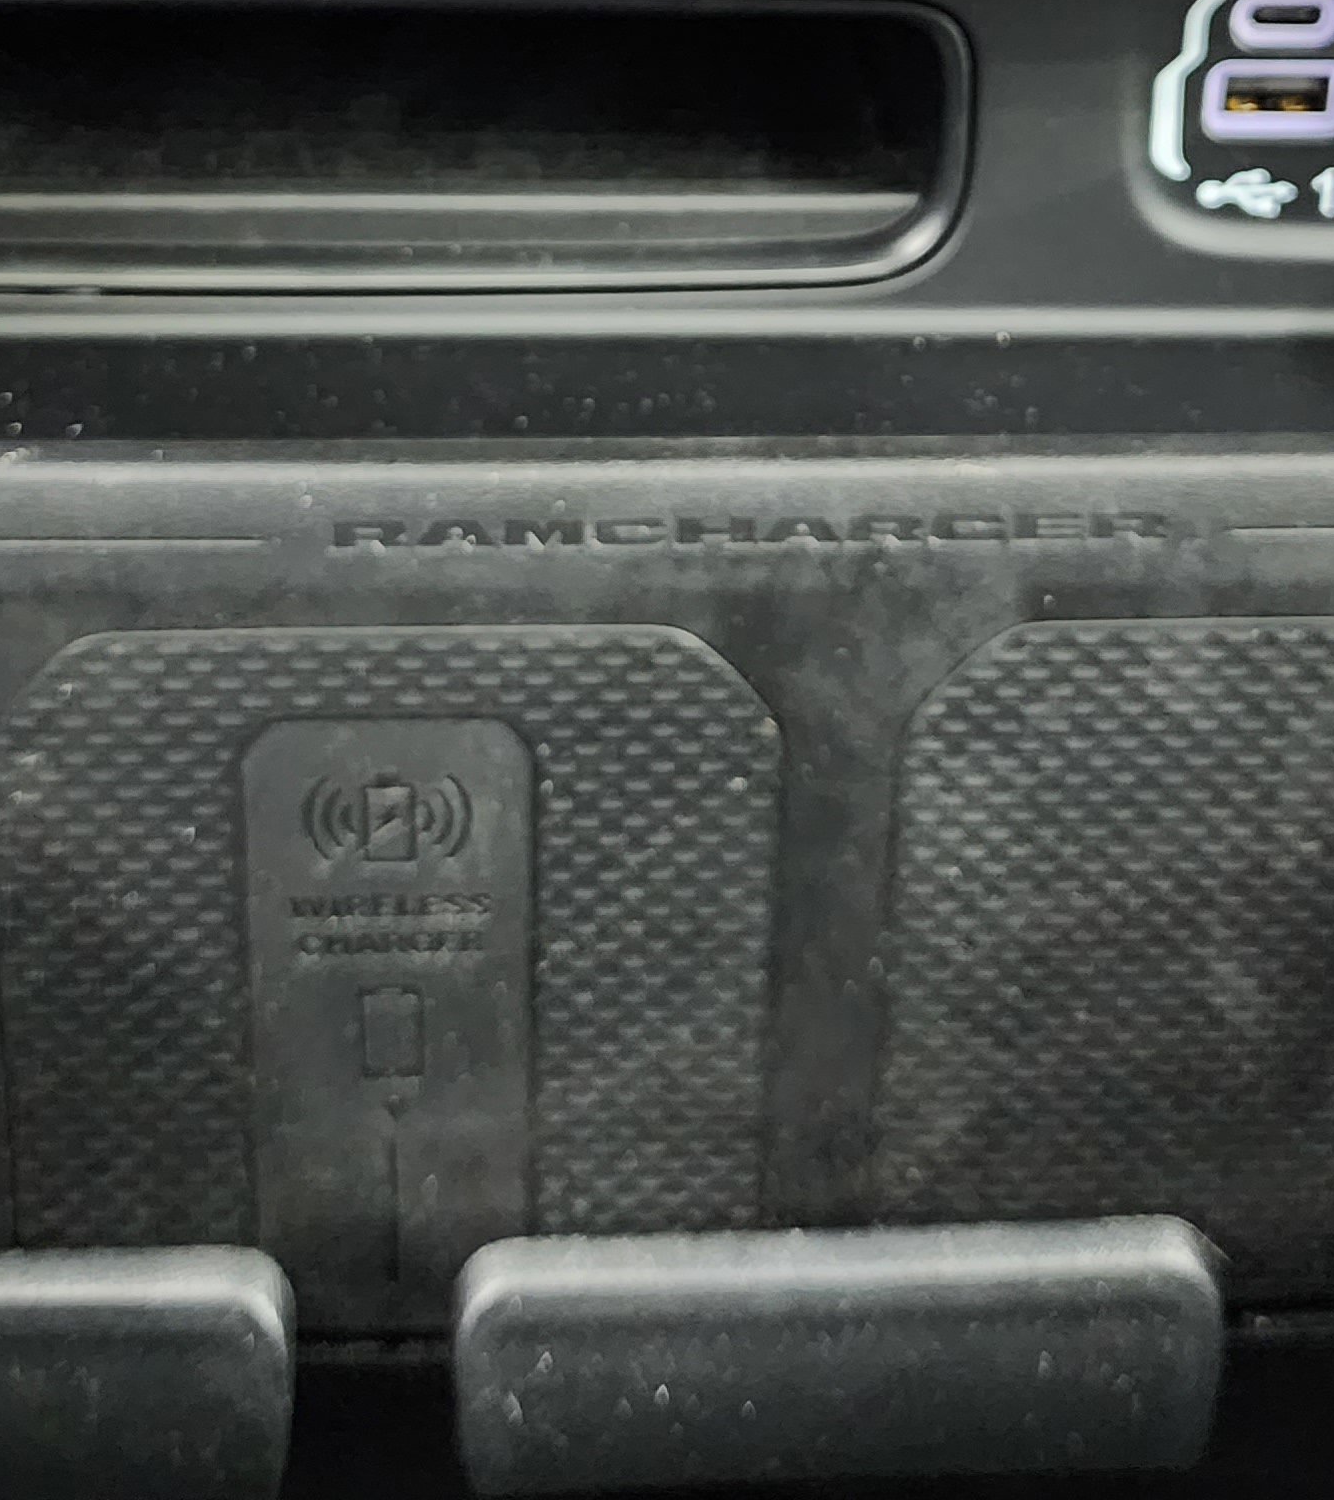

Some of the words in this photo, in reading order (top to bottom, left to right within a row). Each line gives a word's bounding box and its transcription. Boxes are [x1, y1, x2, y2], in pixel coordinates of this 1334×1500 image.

[333, 513, 1168, 548] RAMCHARGER
[289, 893, 492, 917] WIRELESS
[296, 930, 486, 955] CHARGER
